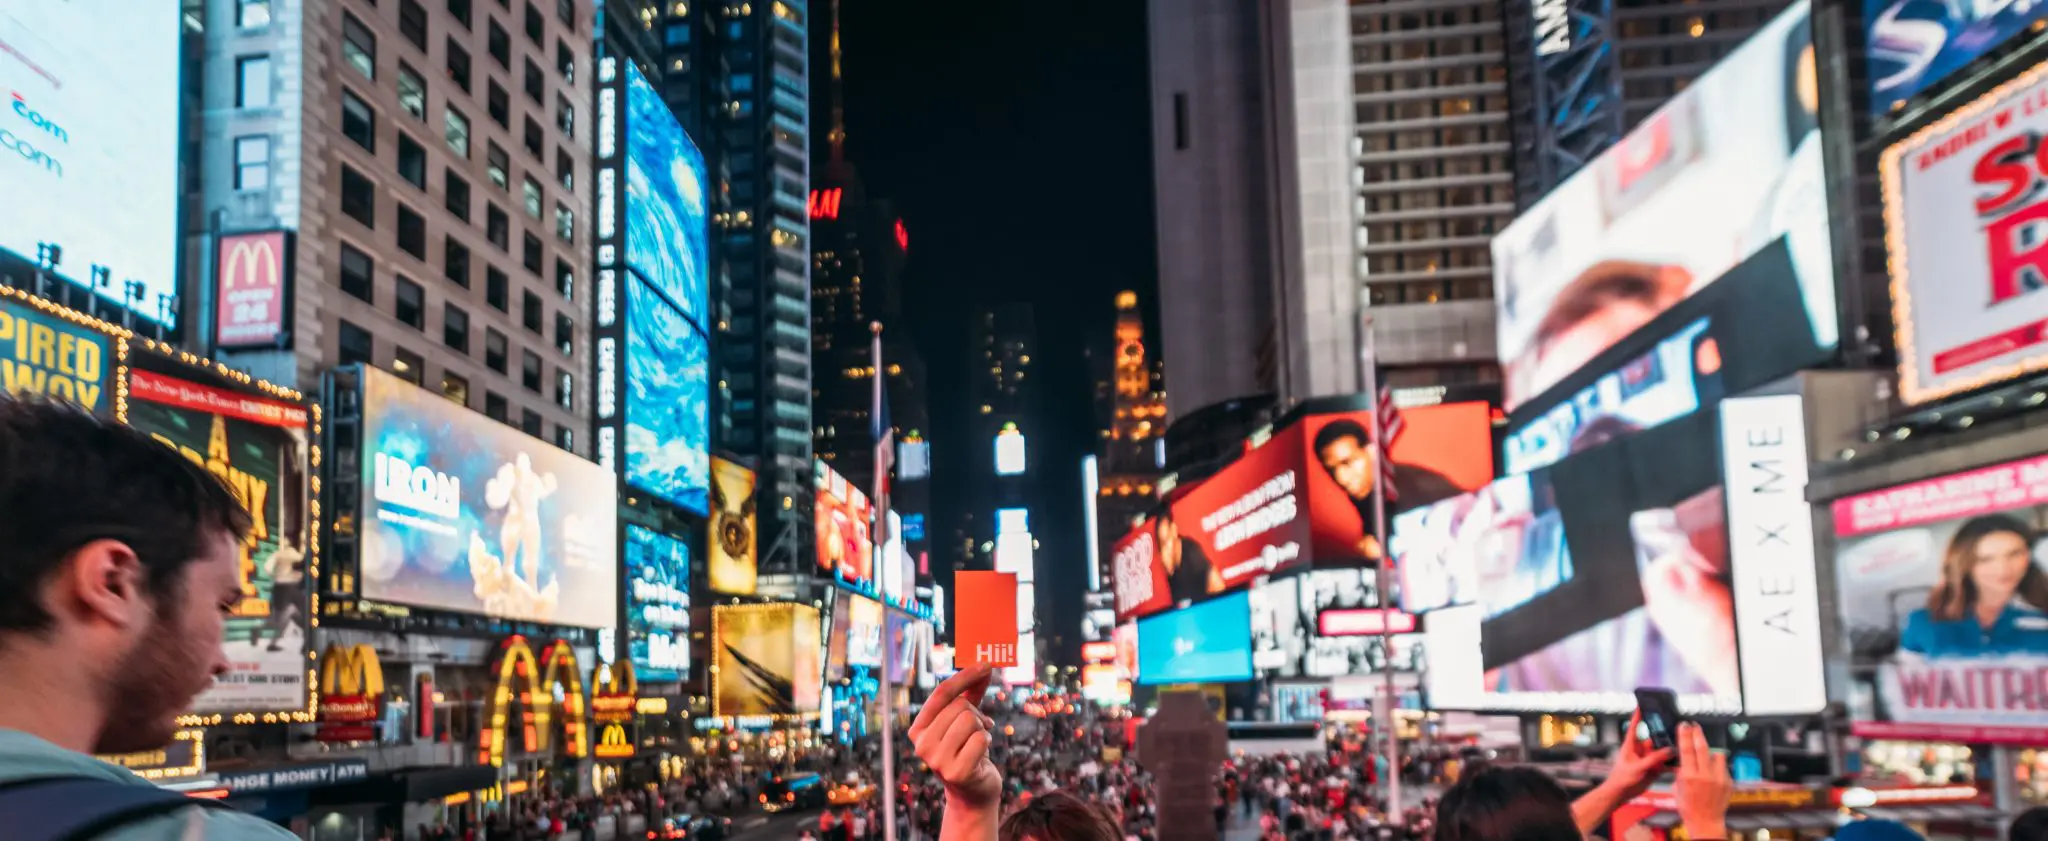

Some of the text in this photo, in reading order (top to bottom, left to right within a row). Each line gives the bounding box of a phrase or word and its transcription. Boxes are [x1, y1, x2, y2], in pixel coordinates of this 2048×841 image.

[12, 100, 68, 144] com
[374, 451, 460, 519] IRON
[976, 643, 1014, 663] Hii!
[274, 767, 328, 786] MONEY
[337, 763, 367, 780] ATM
